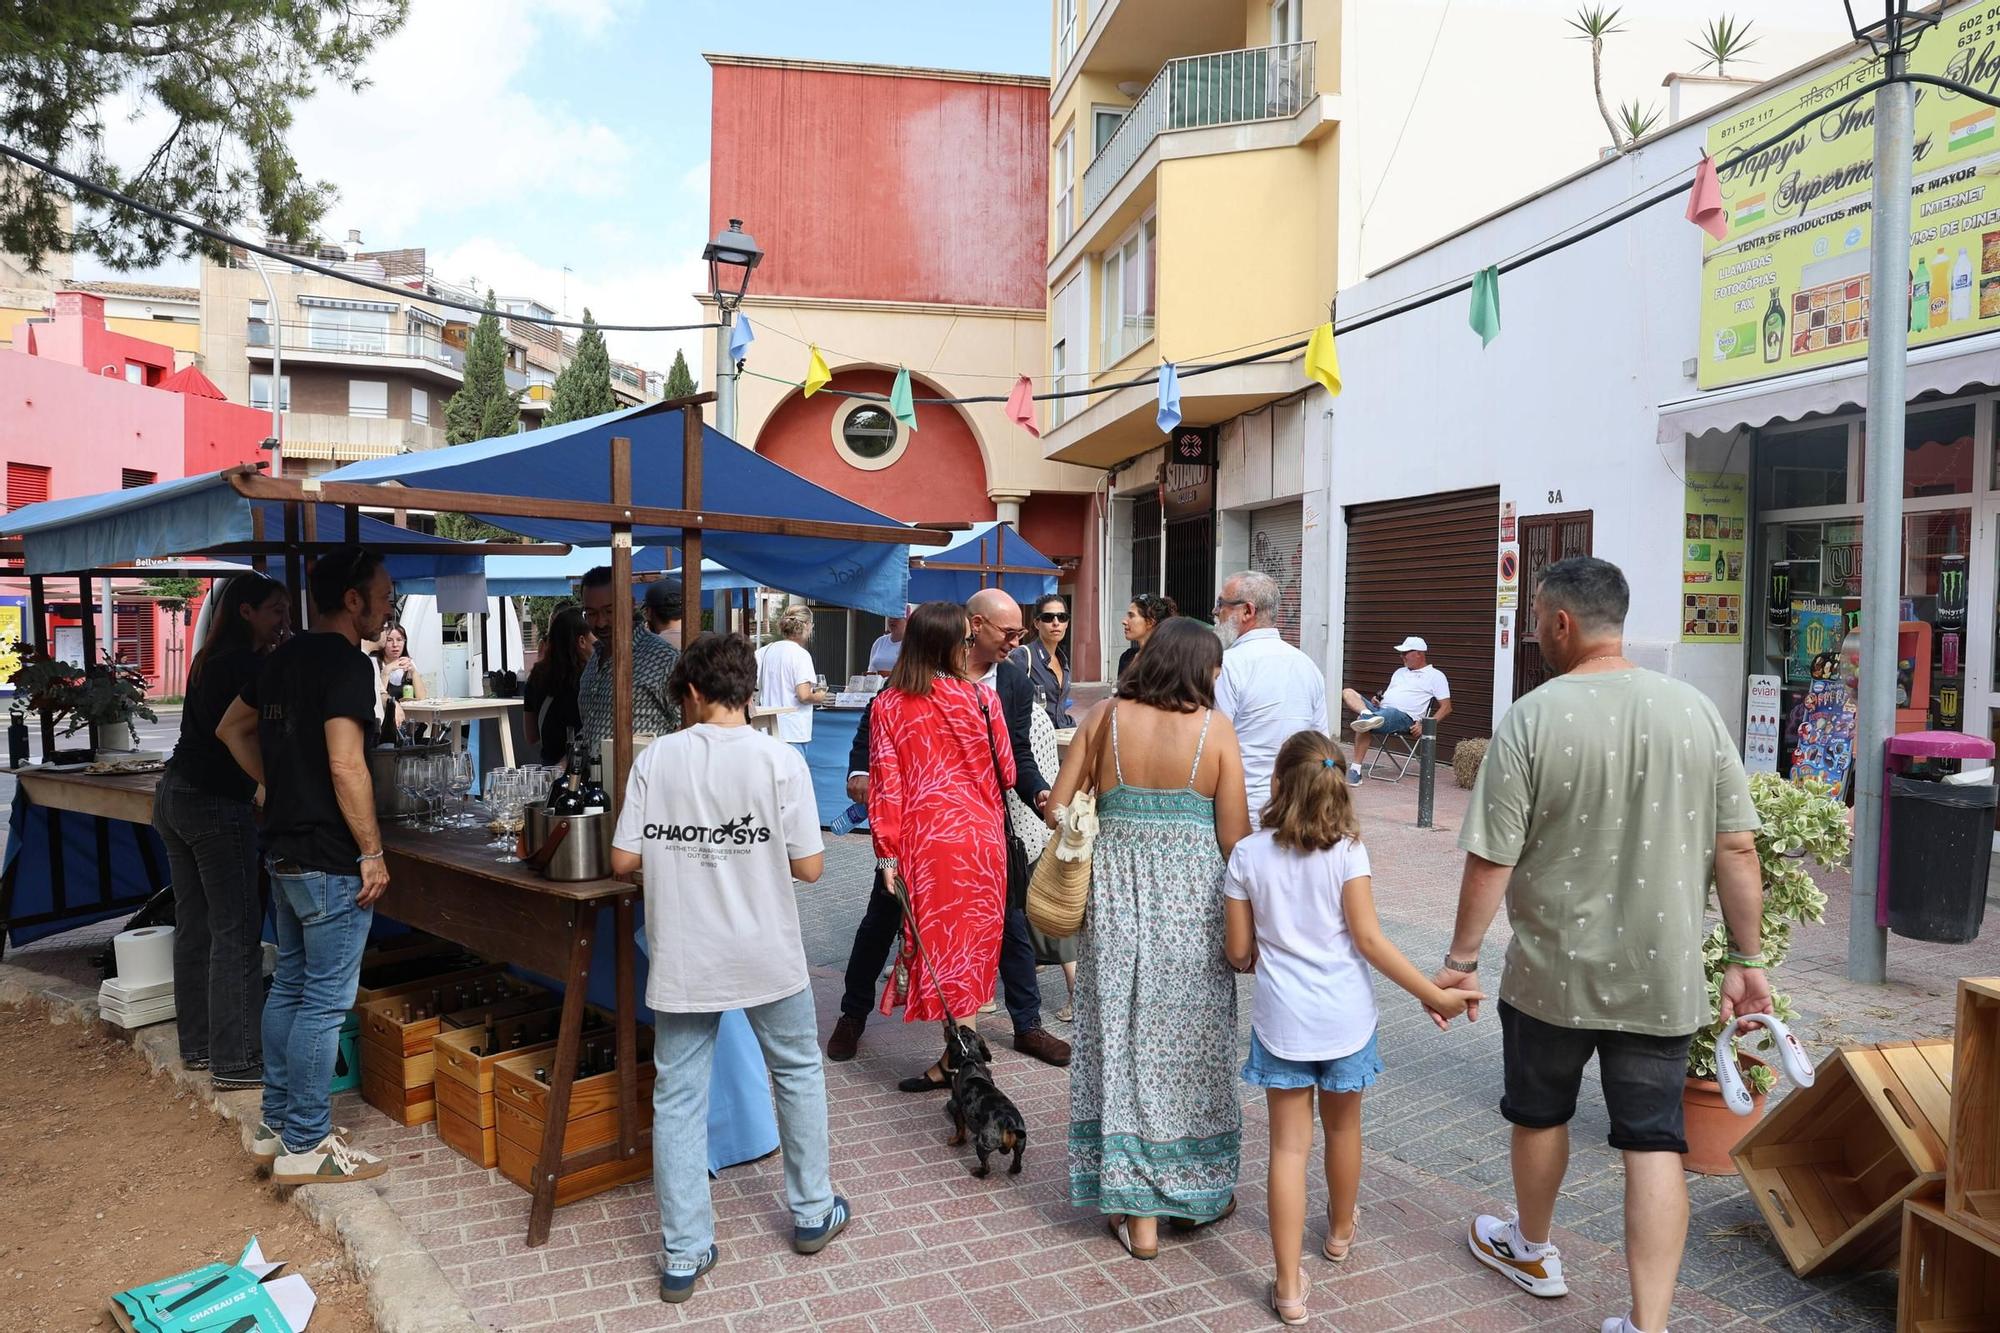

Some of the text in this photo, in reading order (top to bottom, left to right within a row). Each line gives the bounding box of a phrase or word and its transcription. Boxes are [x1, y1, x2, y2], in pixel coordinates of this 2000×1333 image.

[1958, 15, 1983, 32] 602
[1957, 30, 1981, 47] 632
[1721, 109, 1774, 138] 871 572 117
[1737, 238, 1766, 254] VENTA
[1768, 231, 1782, 244] DE
[1783, 210, 1846, 239] PRODUCTOS
[1928, 166, 1977, 191] MAYOR
[1920, 186, 1986, 218] INTERNET
[1940, 219, 1960, 238] DE
[1718, 253, 1773, 280] LLAMADAS
[1733, 297, 1755, 313] FAX
[1548, 489, 1563, 504] 3A
[1752, 686, 1776, 697] evian
[643, 823, 771, 845] CHAOTIC SYS
[188, 1296, 234, 1323] CHATEAU
